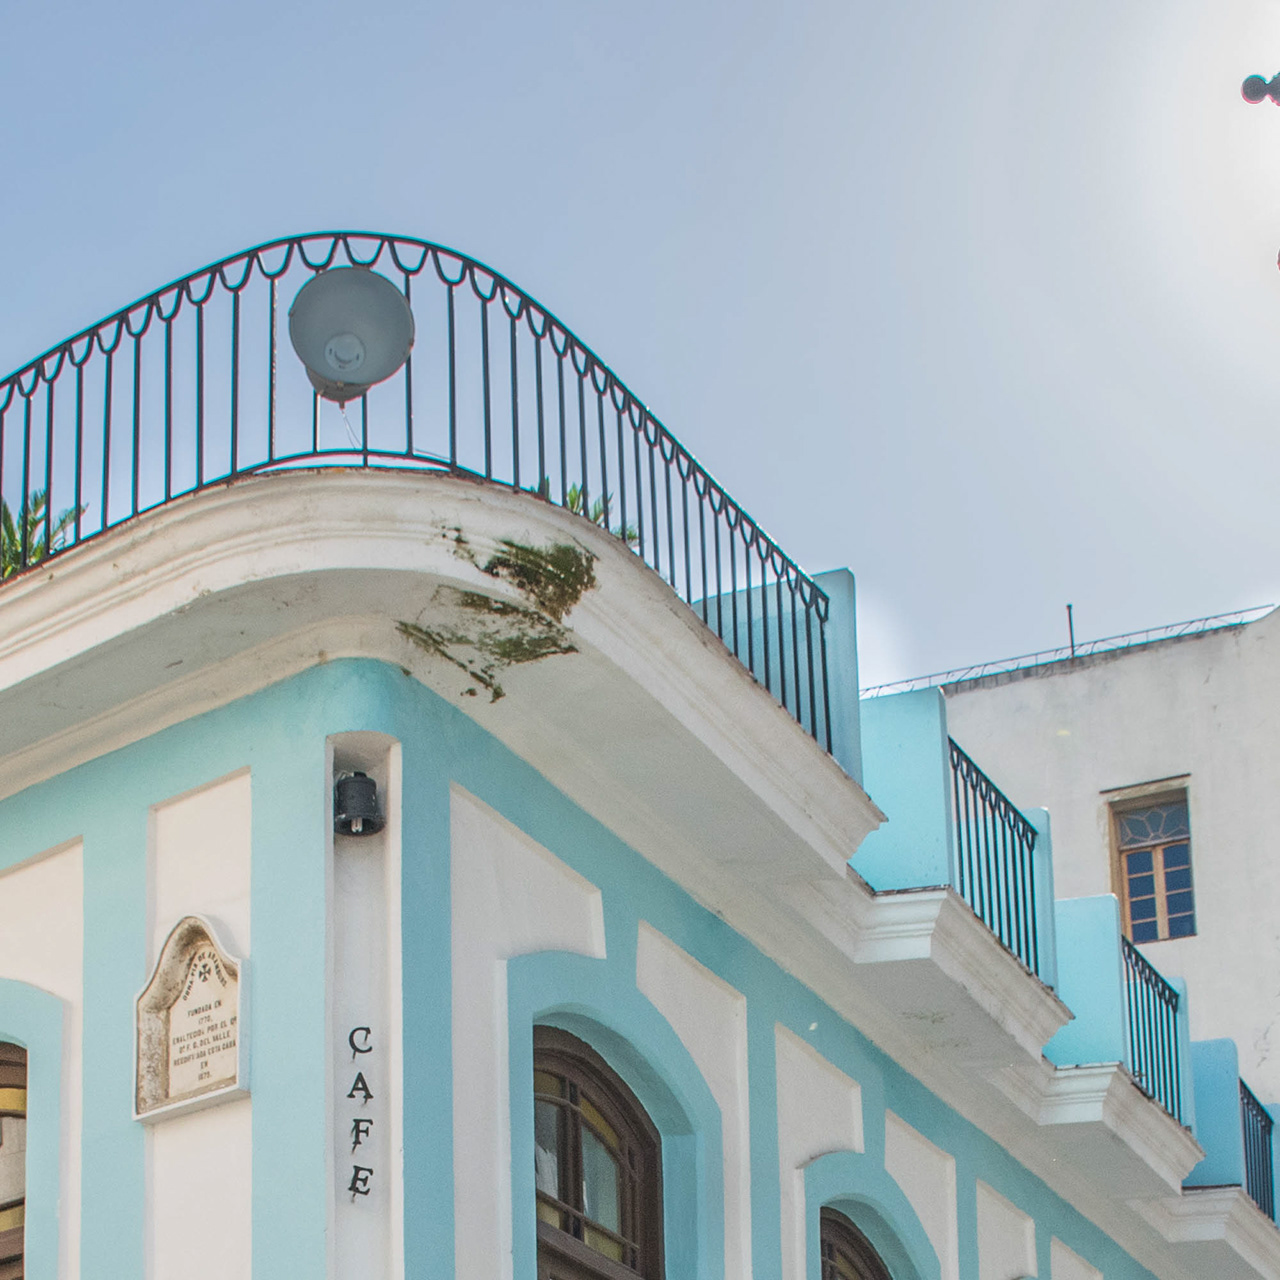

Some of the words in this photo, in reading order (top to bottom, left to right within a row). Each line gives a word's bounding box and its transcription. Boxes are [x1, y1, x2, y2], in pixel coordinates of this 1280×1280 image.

[187, 1002, 212, 1018] FUNDADA
[214, 999, 222, 1008] EN
[347, 1026, 374, 1196] CAFE
